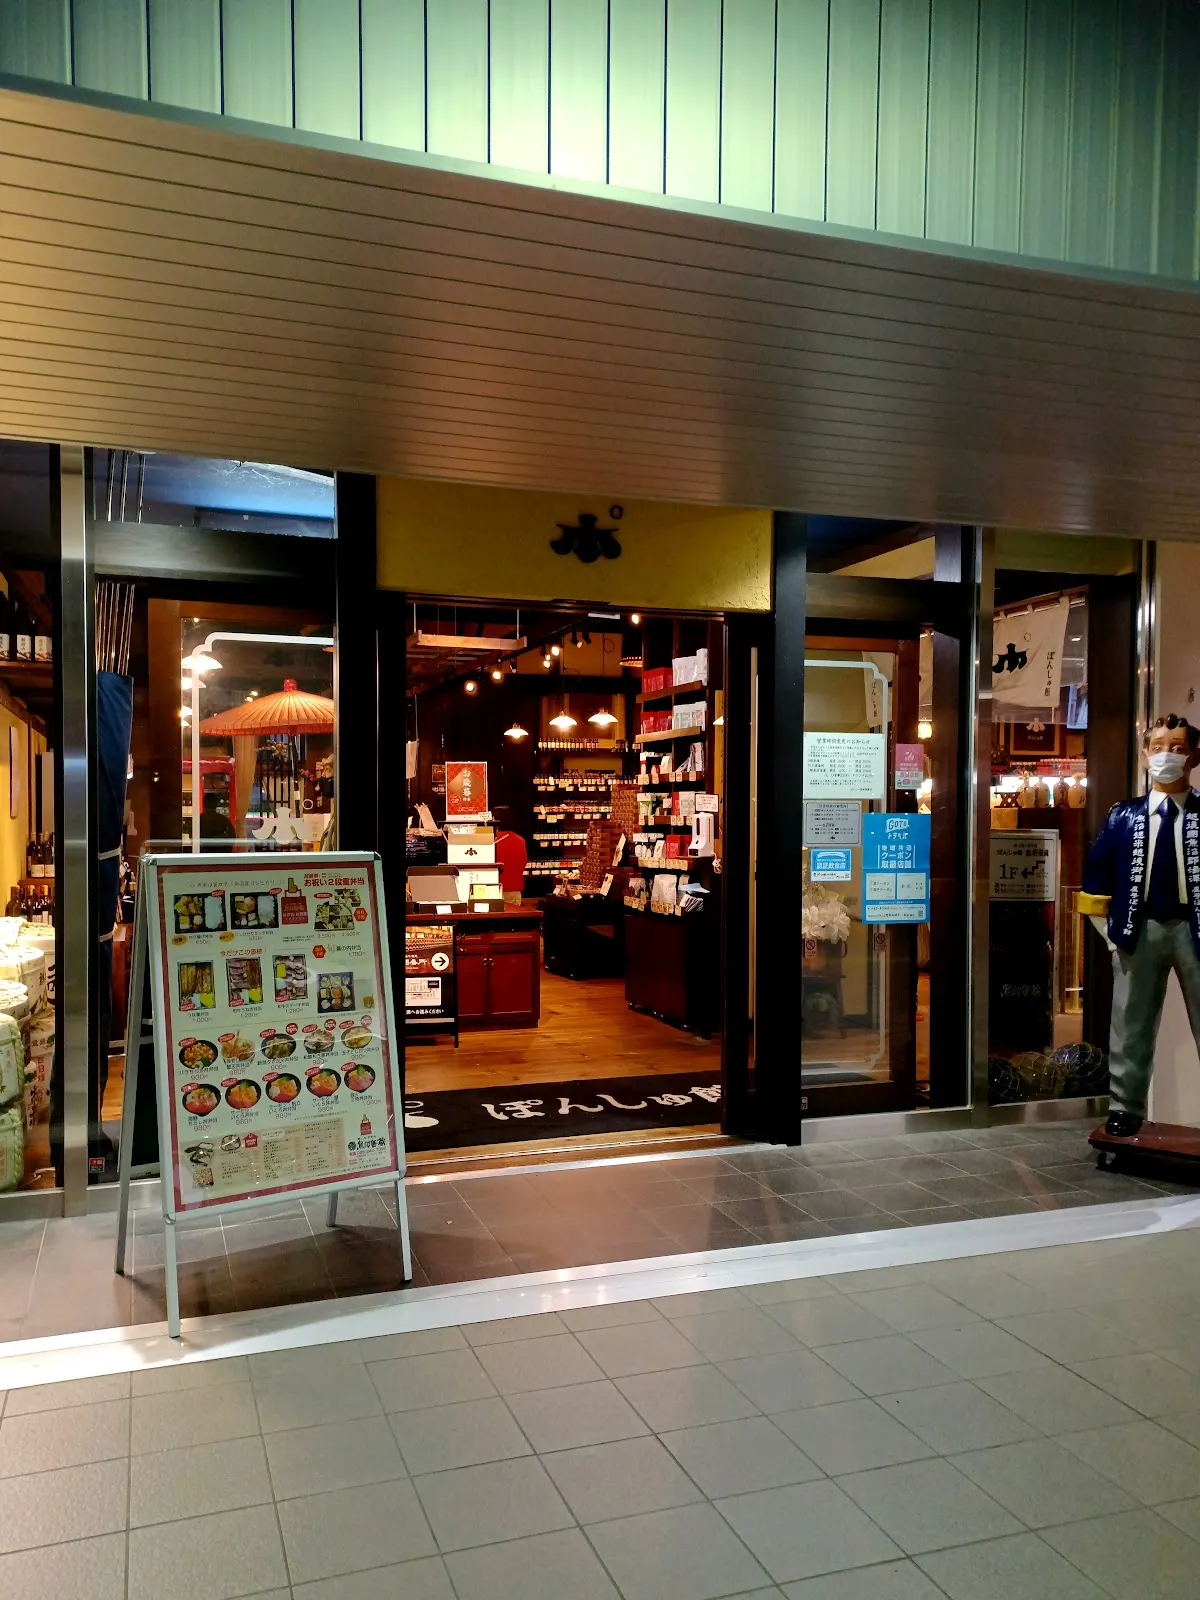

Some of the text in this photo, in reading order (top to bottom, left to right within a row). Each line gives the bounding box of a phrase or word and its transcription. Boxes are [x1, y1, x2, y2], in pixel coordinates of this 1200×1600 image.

[1044, 651, 1055, 697] ぽんしゅ館
[463, 769, 472, 797] お歳暮
[881, 851, 912, 860] クーポン
[881, 860, 912, 869] 取扱店舗
[999, 863, 1019, 880] 1F
[304, 877, 365, 887] お祝い2段重弁当
